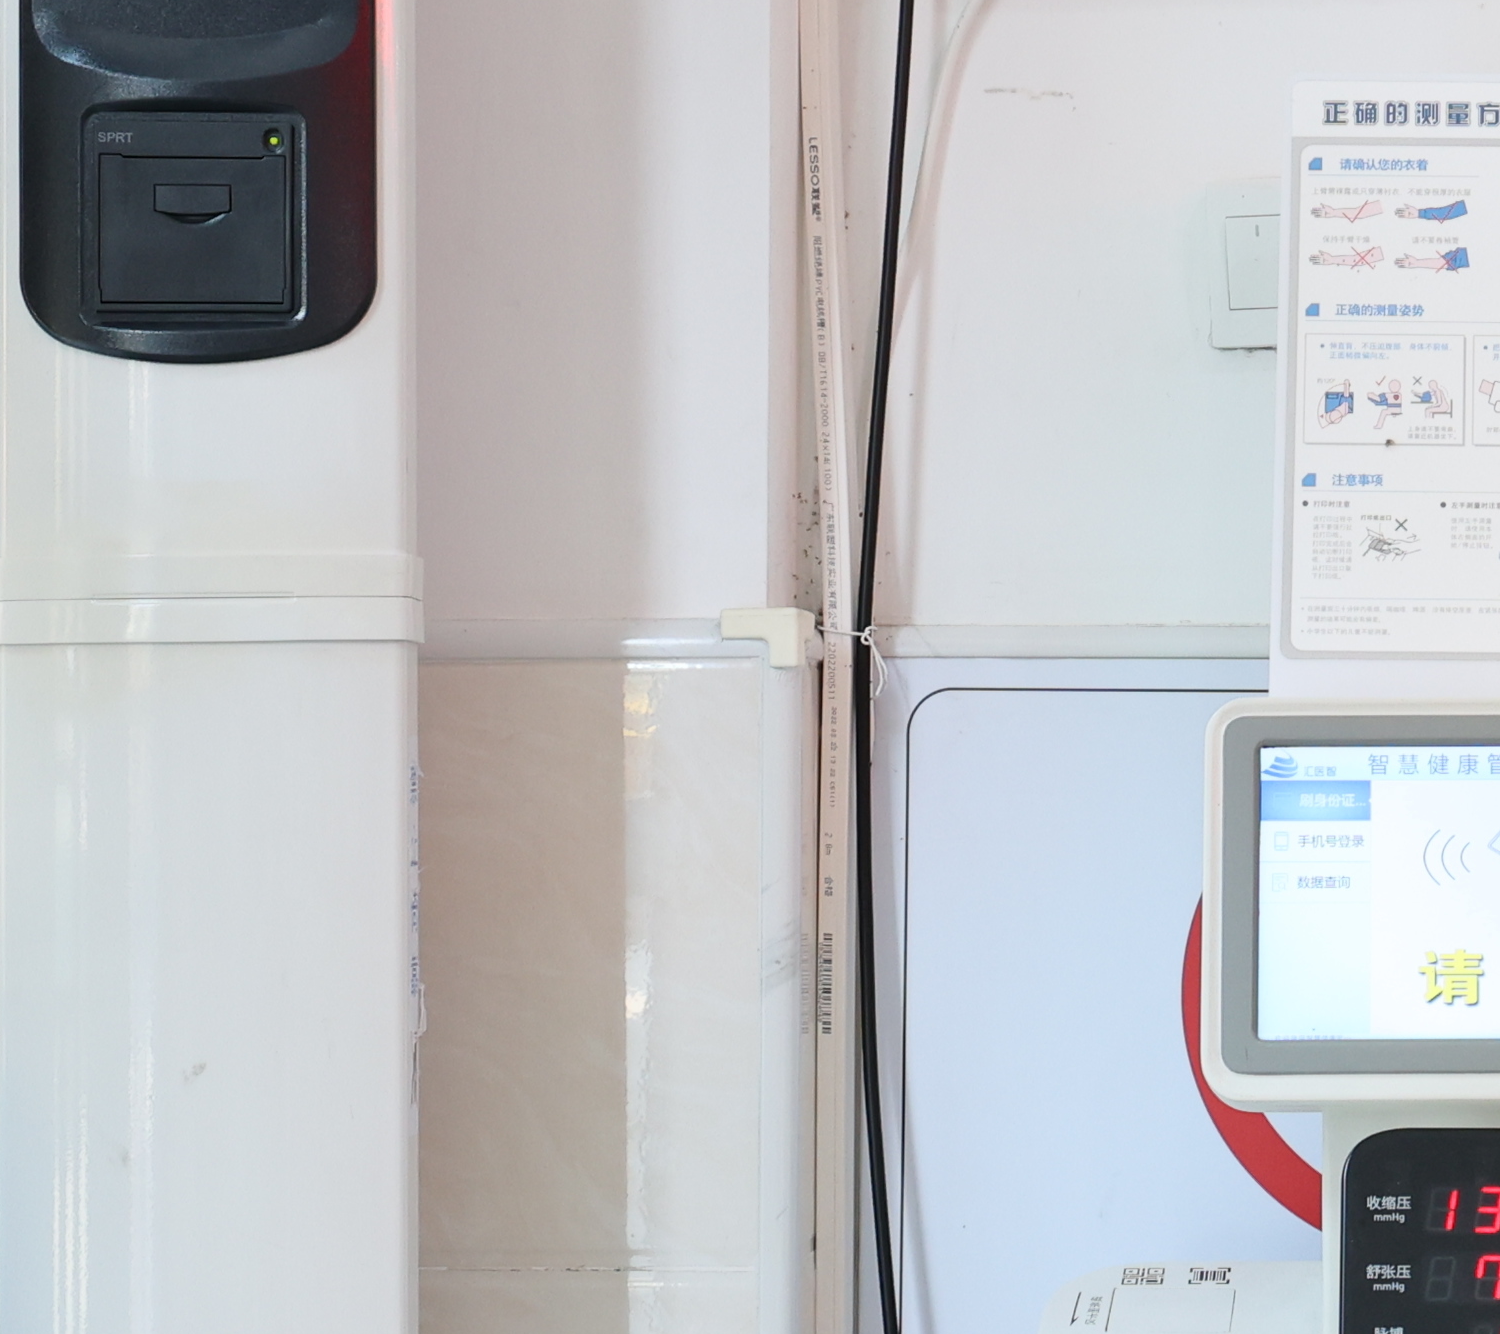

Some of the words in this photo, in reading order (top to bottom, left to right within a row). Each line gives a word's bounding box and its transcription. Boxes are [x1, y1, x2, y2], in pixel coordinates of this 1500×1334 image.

[97, 130, 133, 144] SPRT
[1340, 158, 1428, 171] 请确认您的衣着
[1335, 303, 1424, 317] 正确的测量姿势
[1332, 473, 1384, 487] 注意事项
[1298, 835, 1365, 848] 手机号登录
[1297, 875, 1351, 889] 数据查询
[1366, 1195, 1411, 1211] 收缩压
[1373, 1213, 1405, 1224] mmHg
[1366, 1264, 1411, 1280] 舒张压
[1372, 1282, 1405, 1293] mmHg
